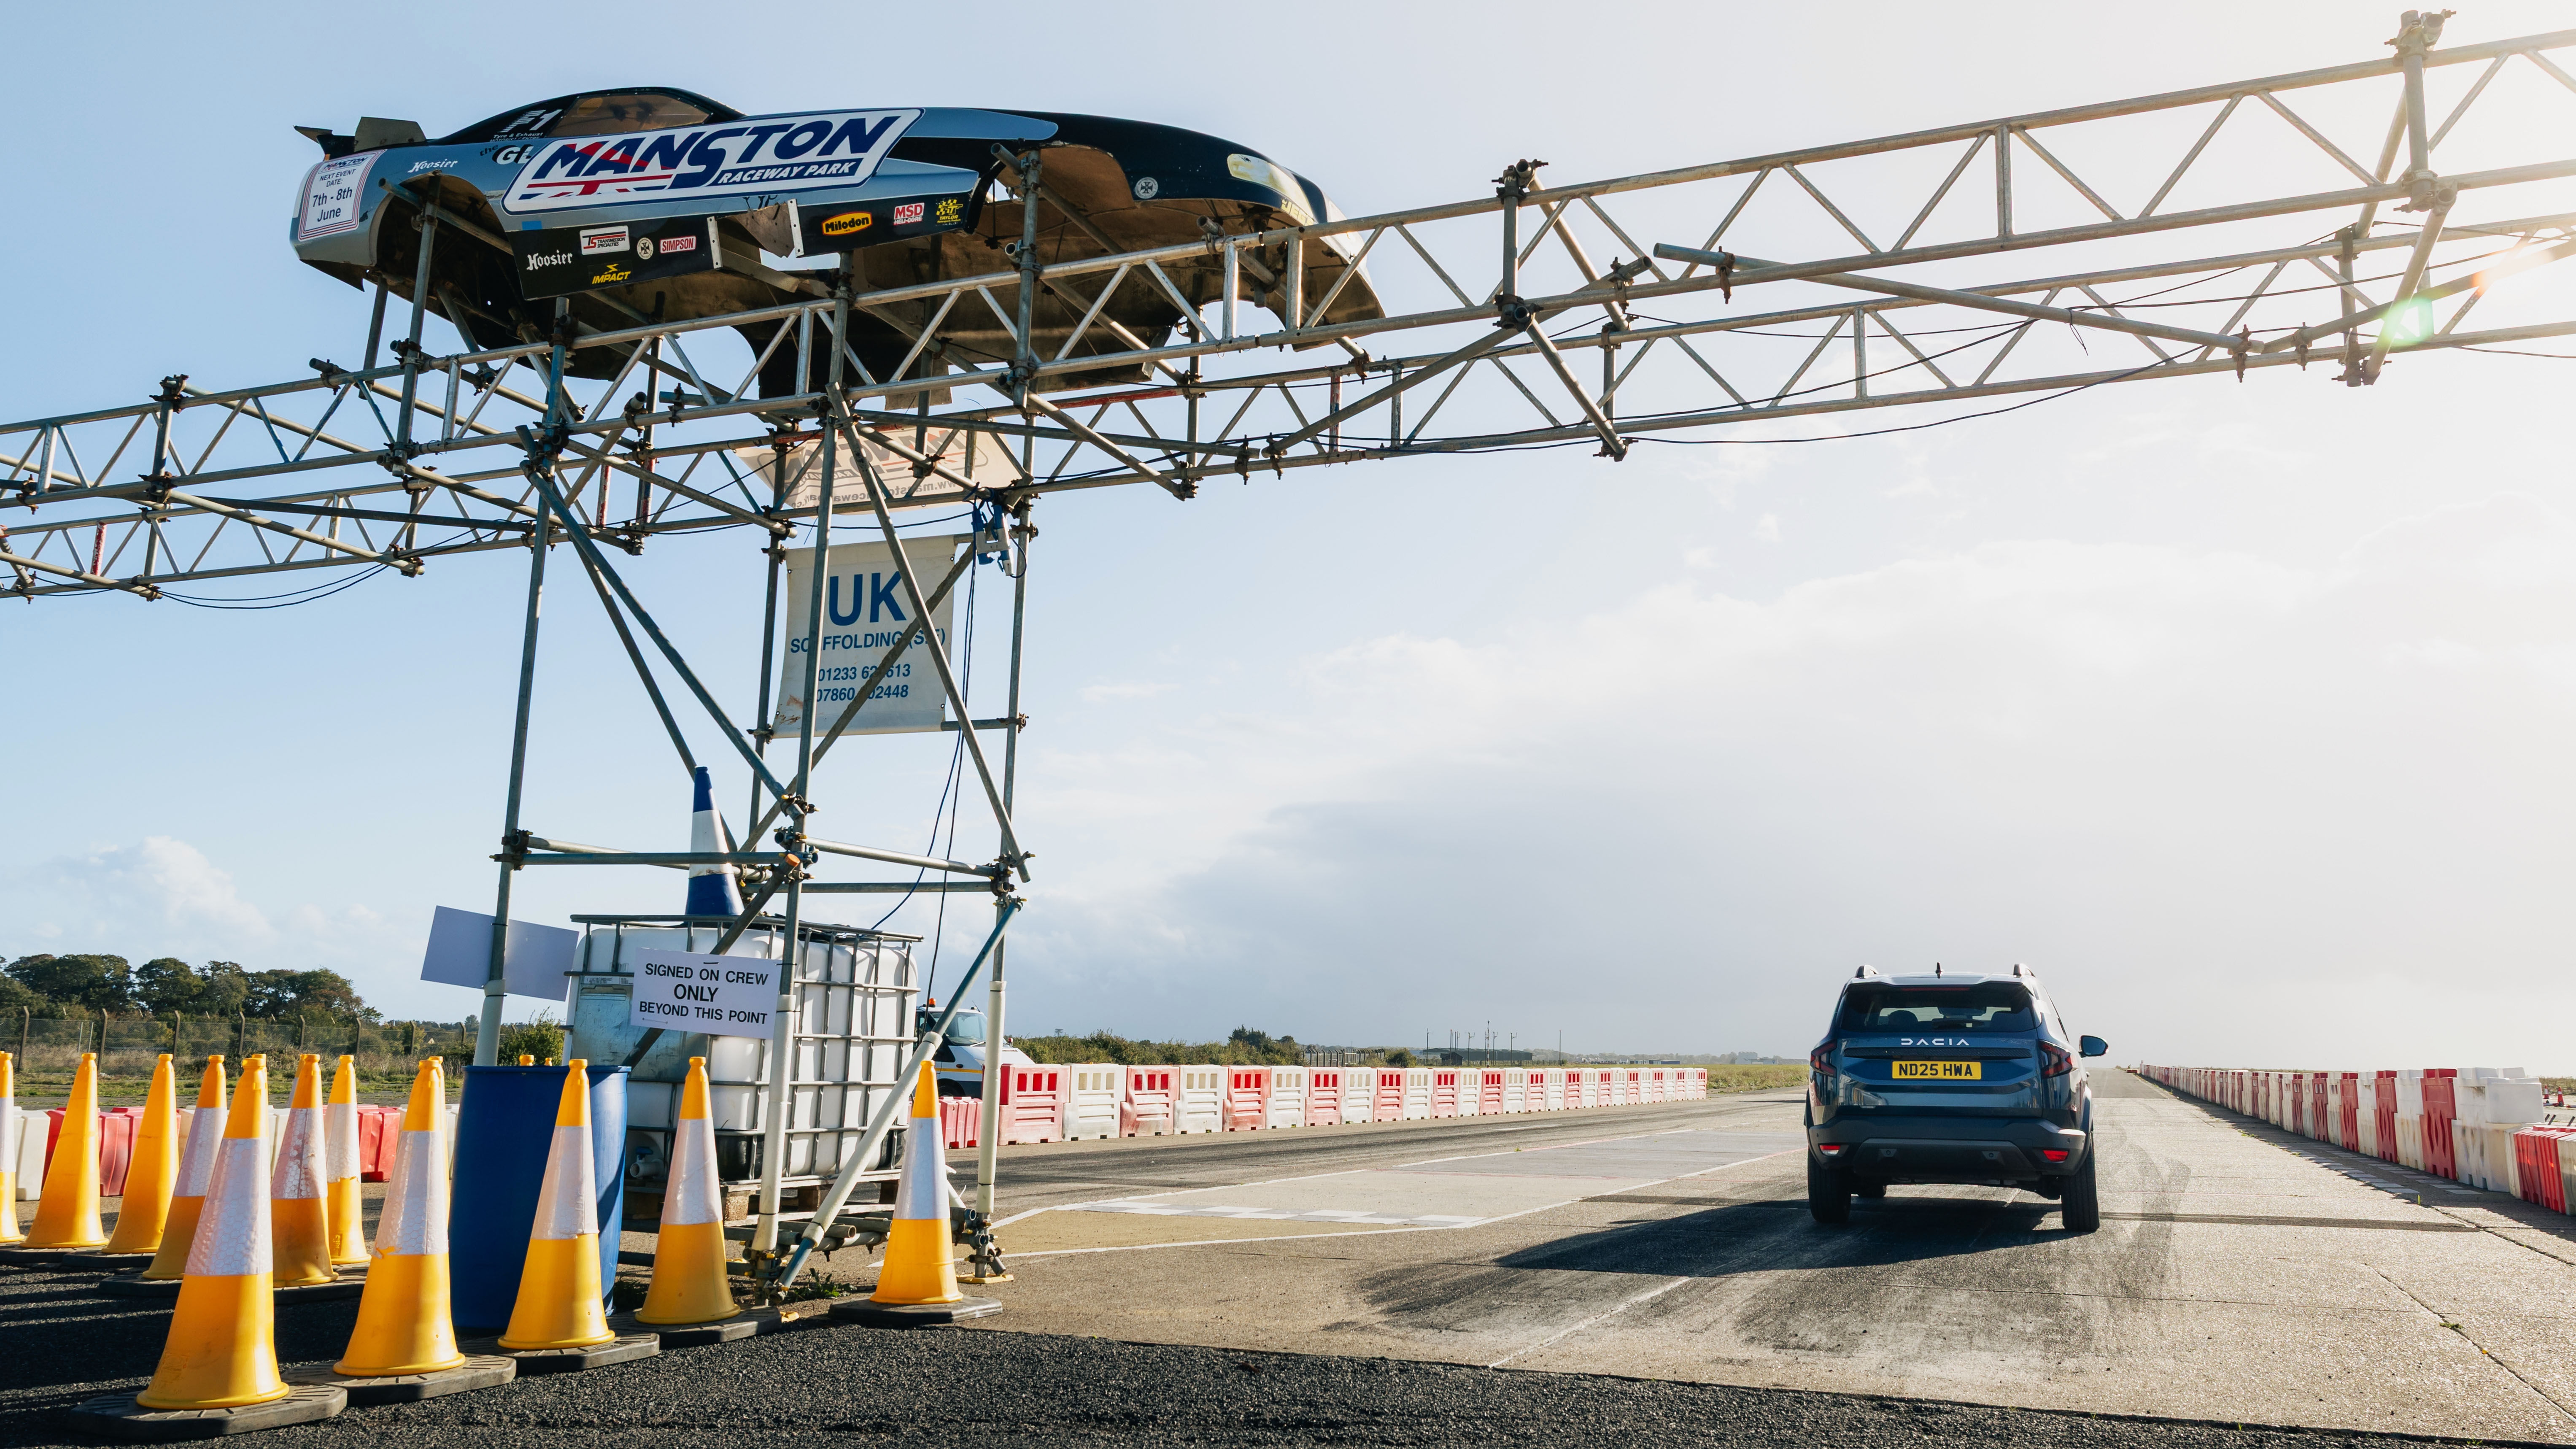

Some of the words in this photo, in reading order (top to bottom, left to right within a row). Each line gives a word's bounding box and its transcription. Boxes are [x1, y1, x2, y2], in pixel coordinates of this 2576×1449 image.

[497, 109, 563, 133] F1
[480, 145, 498, 156] the
[531, 115, 902, 190] MANSTON
[407, 159, 458, 173] Hoosier
[718, 166, 805, 184] RACEWAY
[803, 162, 856, 176] PARK
[319, 173, 335, 181] NEXT
[335, 169, 356, 178] EVENT
[326, 178, 343, 187] DATE:
[313, 193, 327, 207] 7th
[336, 187, 352, 201] 8th
[317, 208, 341, 222] June
[895, 204, 923, 219] MSD
[825, 217, 869, 233] Milodon
[662, 237, 694, 252] SIMPSON
[526, 249, 573, 270] Hoosier
[592, 271, 631, 284] IMPACT
[828, 571, 907, 626] UK
[790, 631, 904, 653] SCFFOLDING
[818, 666, 857, 682] 01233
[861, 664, 911, 680] 62613
[816, 687, 855, 702] 07860
[645, 963, 693, 979] SIGNED
[699, 968, 720, 981] ON
[725, 970, 769, 985] CREW
[674, 983, 719, 1002] ONLY
[639, 1001, 689, 1017] BEYOND
[694, 1006, 723, 1020] THIS
[728, 1010, 768, 1025] POINT
[1901, 1038, 1970, 1046] DACIA
[1899, 1063, 1939, 1076] ND25
[1943, 1063, 1973, 1077] HWA
